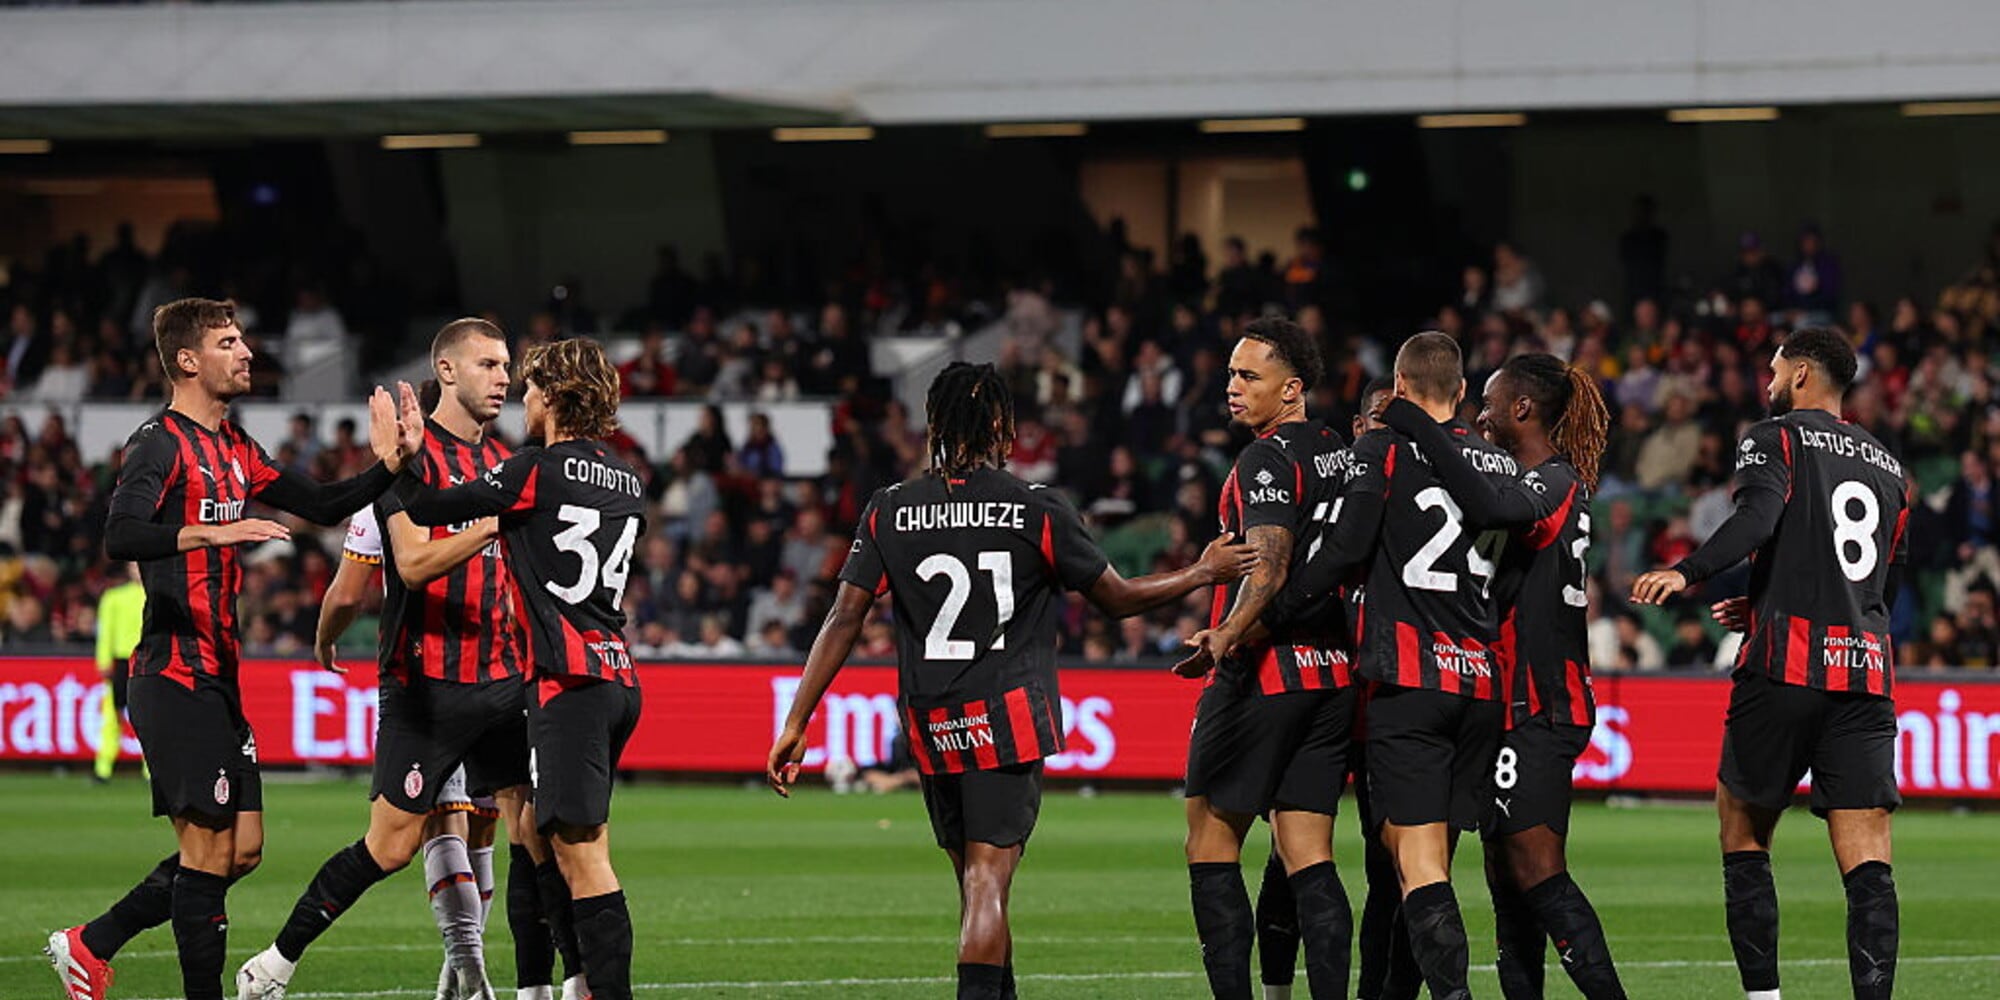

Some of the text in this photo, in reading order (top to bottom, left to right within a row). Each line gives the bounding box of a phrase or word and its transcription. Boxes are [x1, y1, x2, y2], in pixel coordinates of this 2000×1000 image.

[564, 457, 642, 498] COMOTTO
[1249, 487, 1290, 505] MSC
[895, 502, 1026, 531] CHUKWUEZE
[1831, 480, 1880, 582] 8
[545, 503, 641, 612] 34
[1402, 486, 1510, 600] 24
[915, 551, 1015, 660] 21
[1294, 650, 1349, 668] MILAN
[1435, 655, 1491, 678] MILAN
[1824, 648, 1884, 673] MILAN
[933, 727, 994, 752] MILAN
[1495, 747, 1518, 789] 8
